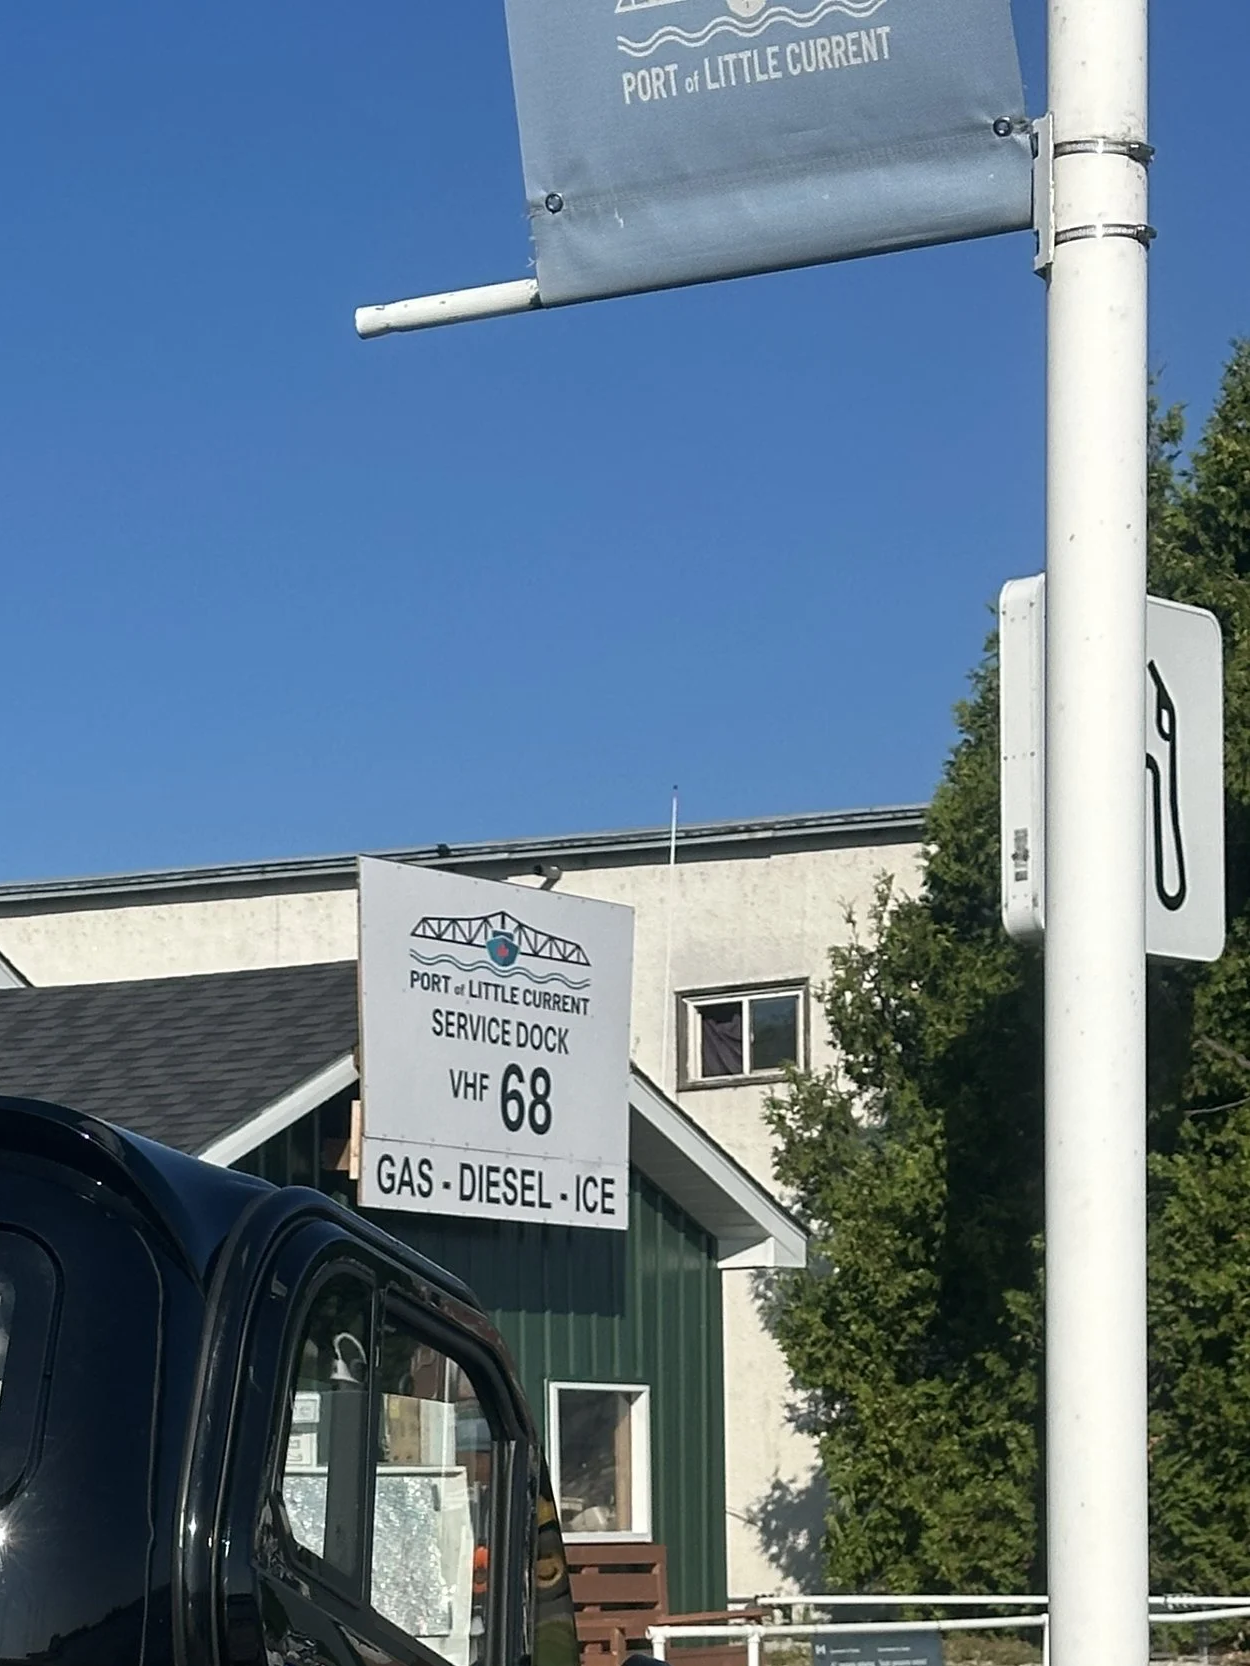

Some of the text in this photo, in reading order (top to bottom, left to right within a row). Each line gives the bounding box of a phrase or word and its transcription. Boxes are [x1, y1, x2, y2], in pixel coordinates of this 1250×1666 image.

[622, 26, 891, 104] PORT of LITTLE CURRENT
[410, 970, 590, 1015] PORT of LITTLE CURRENT
[432, 1008, 569, 1055] SERVICE DOCK
[449, 1063, 552, 1135] VHF 68
[377, 1153, 434, 1198] GAS
[459, 1162, 552, 1209] DIESEL
[575, 1174, 615, 1214] ICE
